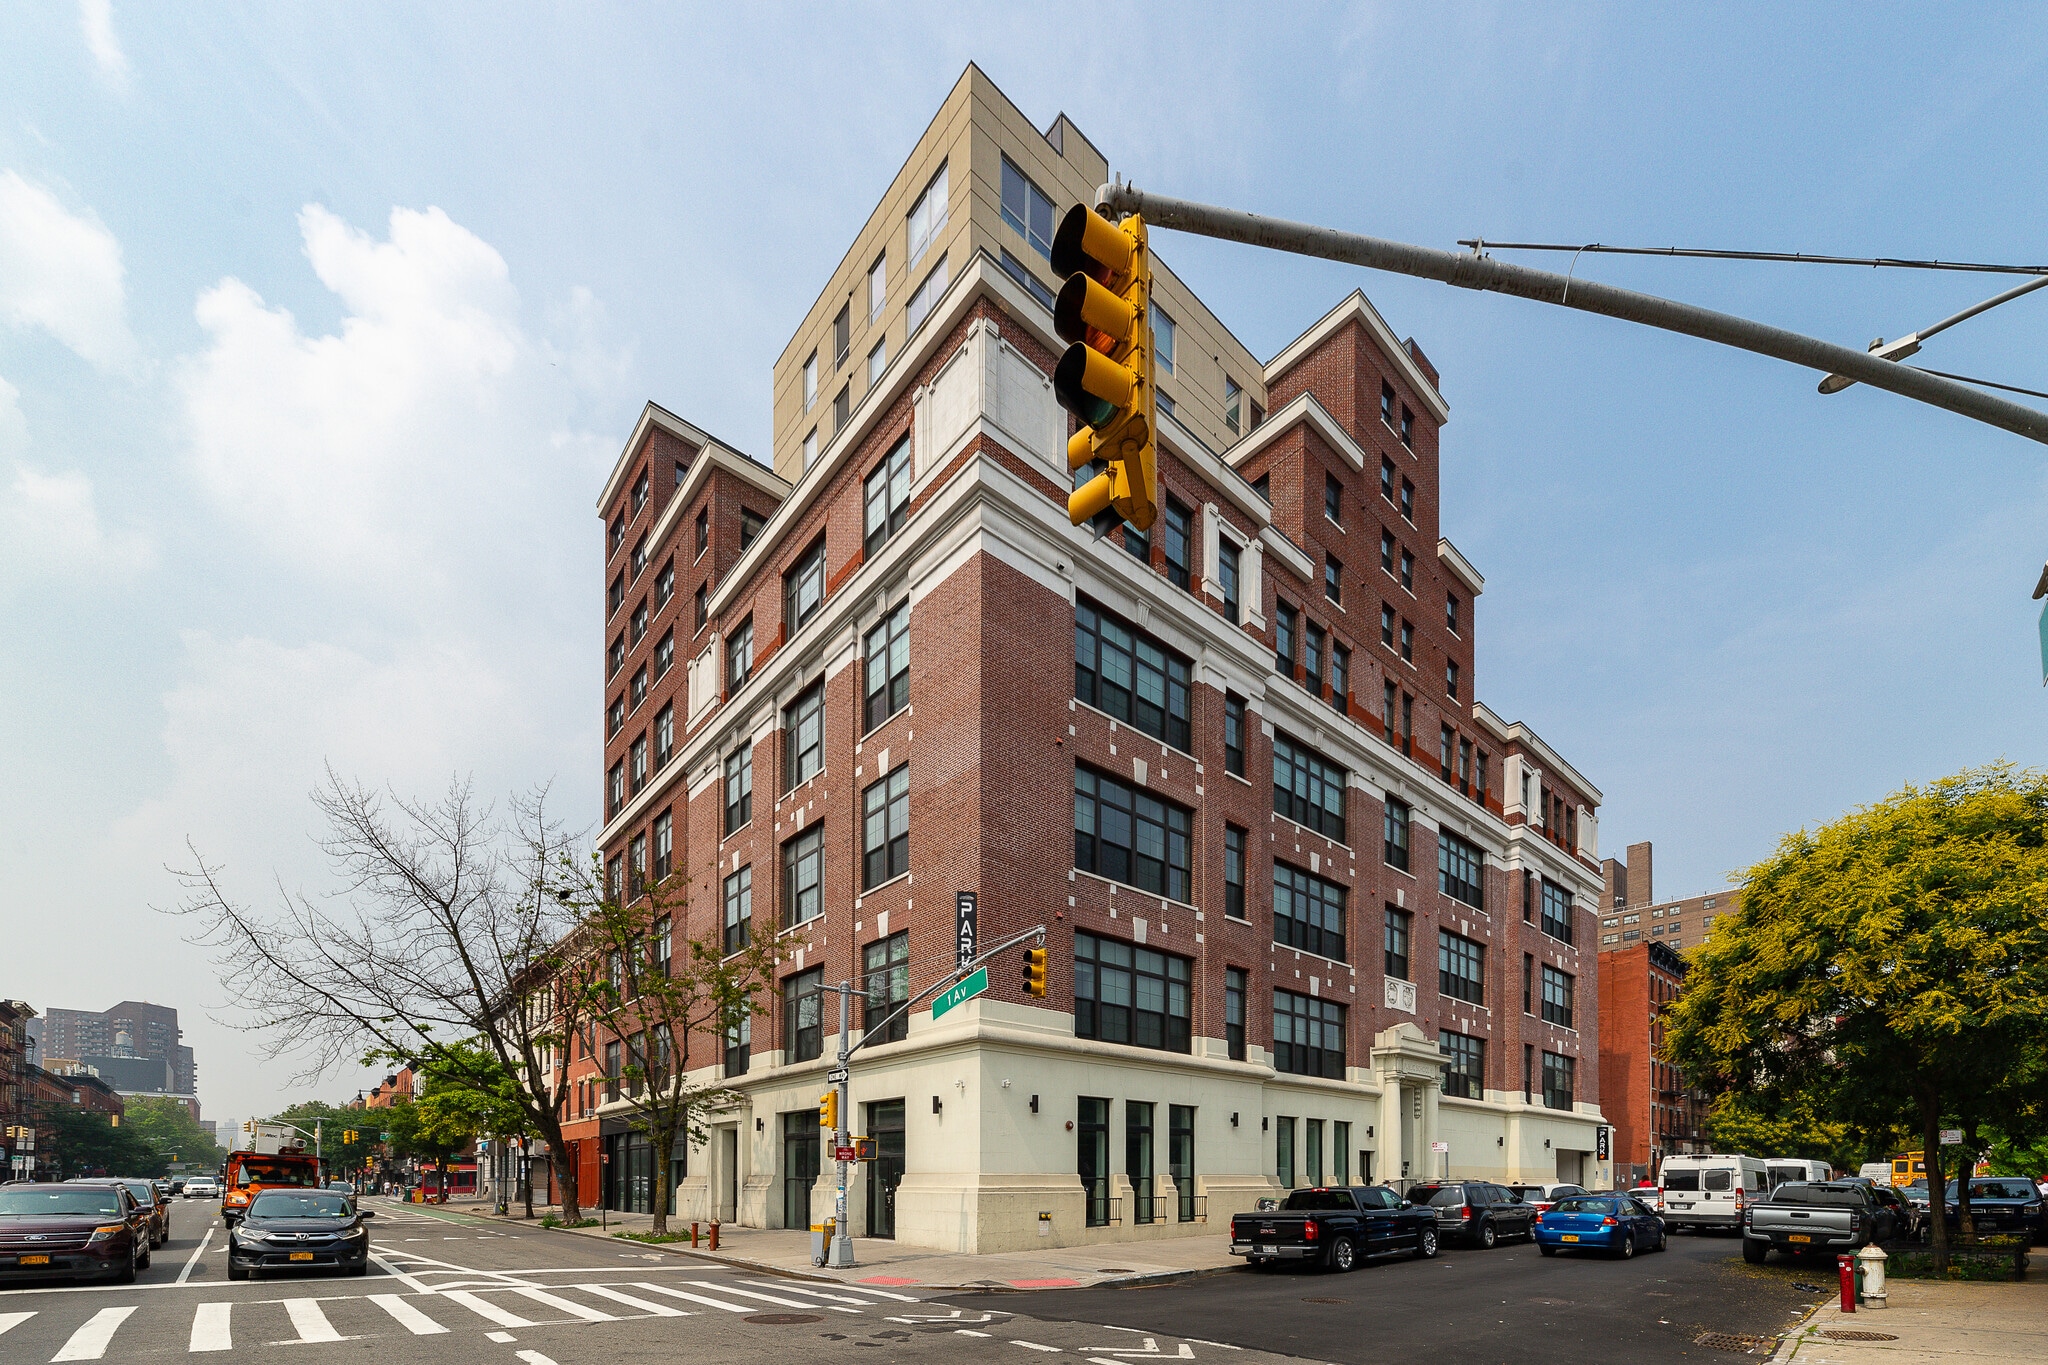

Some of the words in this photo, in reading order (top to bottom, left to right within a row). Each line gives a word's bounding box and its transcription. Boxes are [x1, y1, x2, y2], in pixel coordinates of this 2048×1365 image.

[960, 901, 973, 970] PARK
[947, 994, 951, 1006] 1
[953, 986, 967, 1003] Av
